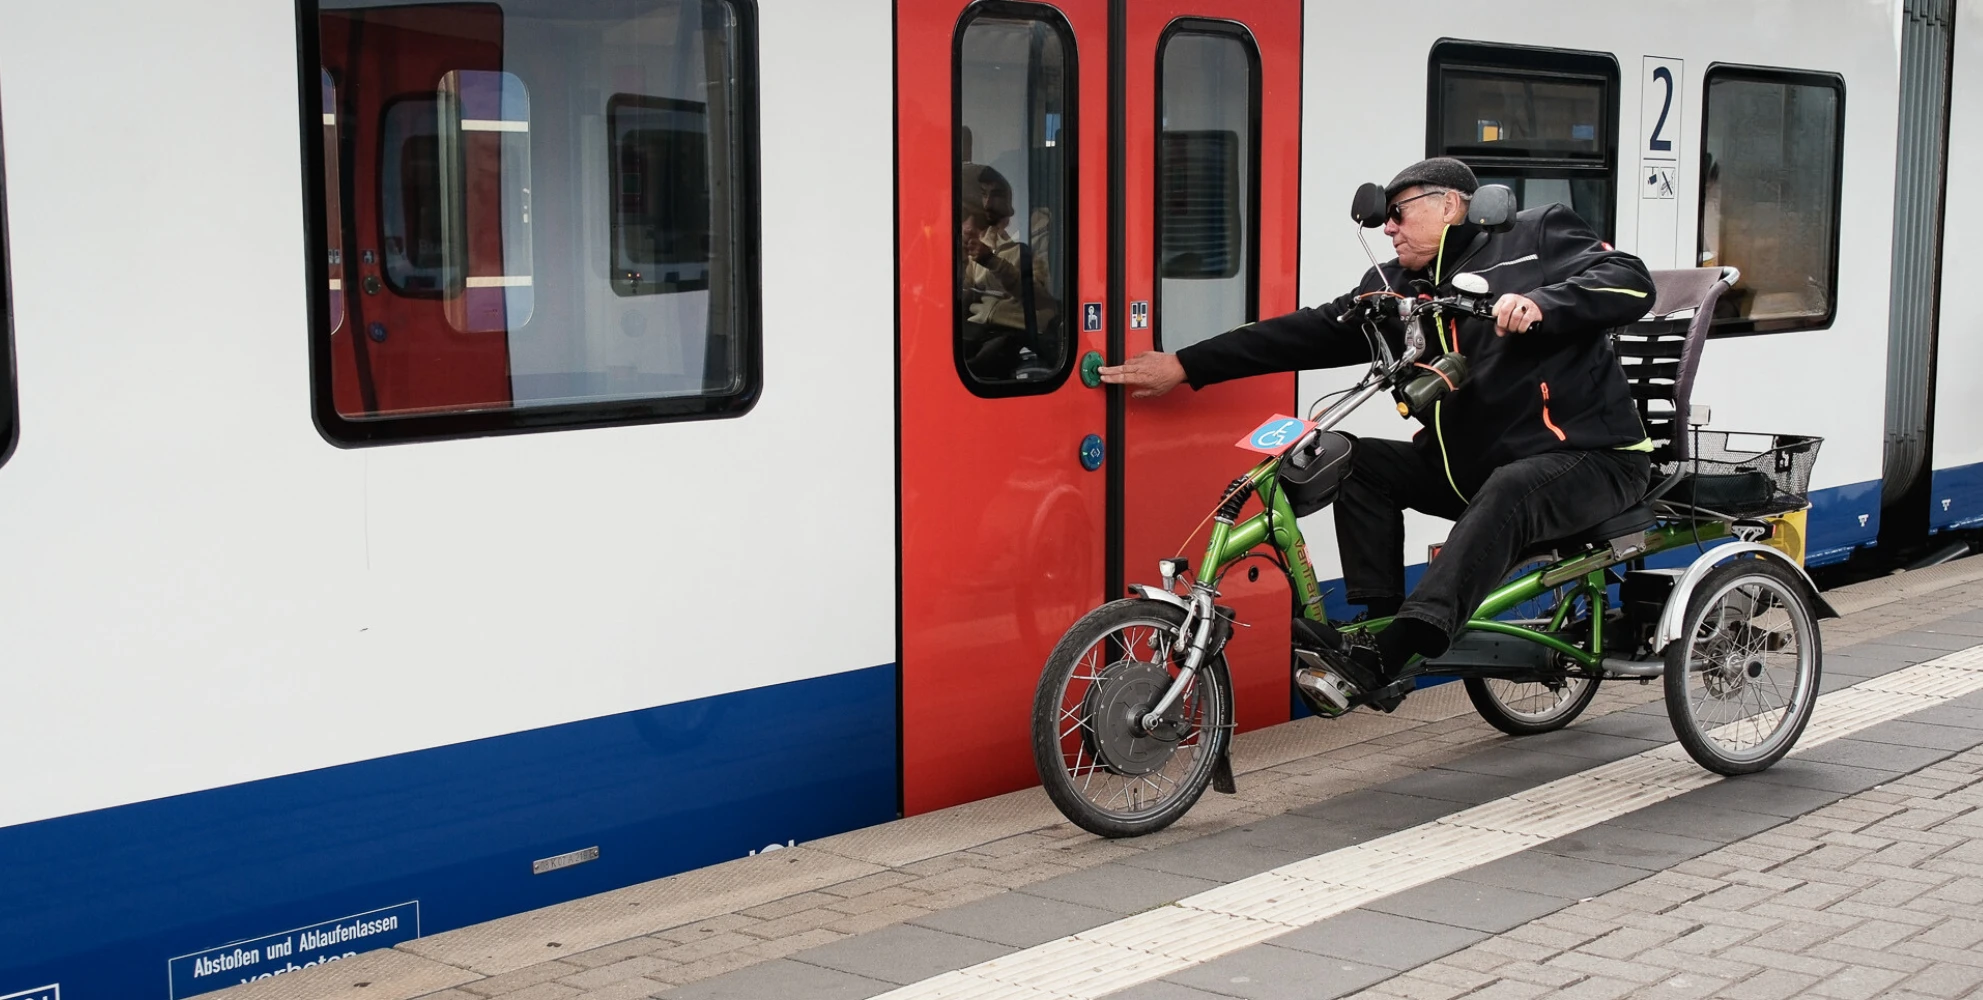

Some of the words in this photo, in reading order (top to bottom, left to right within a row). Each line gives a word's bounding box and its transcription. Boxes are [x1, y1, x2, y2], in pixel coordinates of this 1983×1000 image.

[1650, 66, 1673, 151] 2
[194, 948, 259, 978] Abstoßen
[267, 936, 292, 961] und
[299, 915, 398, 952] Ablaufenlassen
